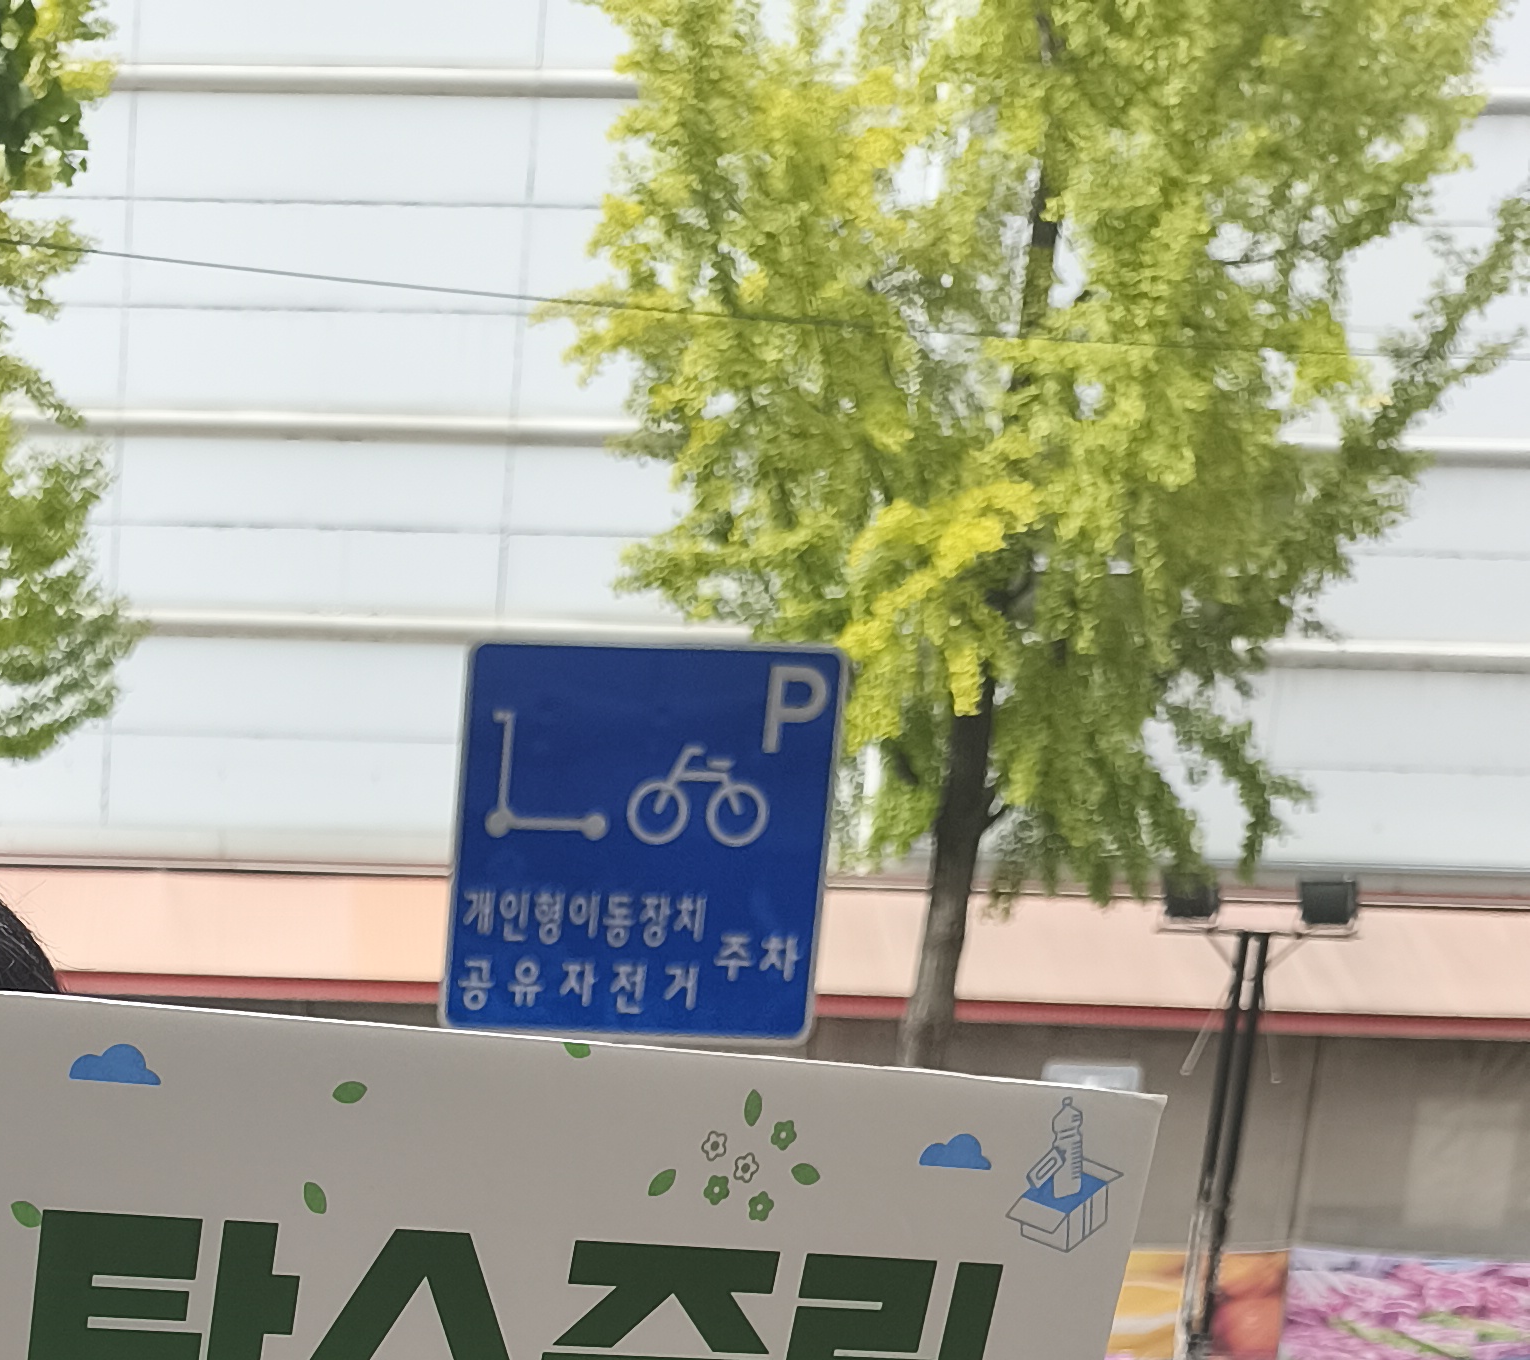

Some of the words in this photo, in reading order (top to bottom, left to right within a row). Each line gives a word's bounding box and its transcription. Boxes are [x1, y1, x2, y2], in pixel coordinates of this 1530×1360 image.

[762, 666, 827, 754] P
[463, 889, 707, 948] 개인형이동장치
[714, 934, 799, 983] 주차
